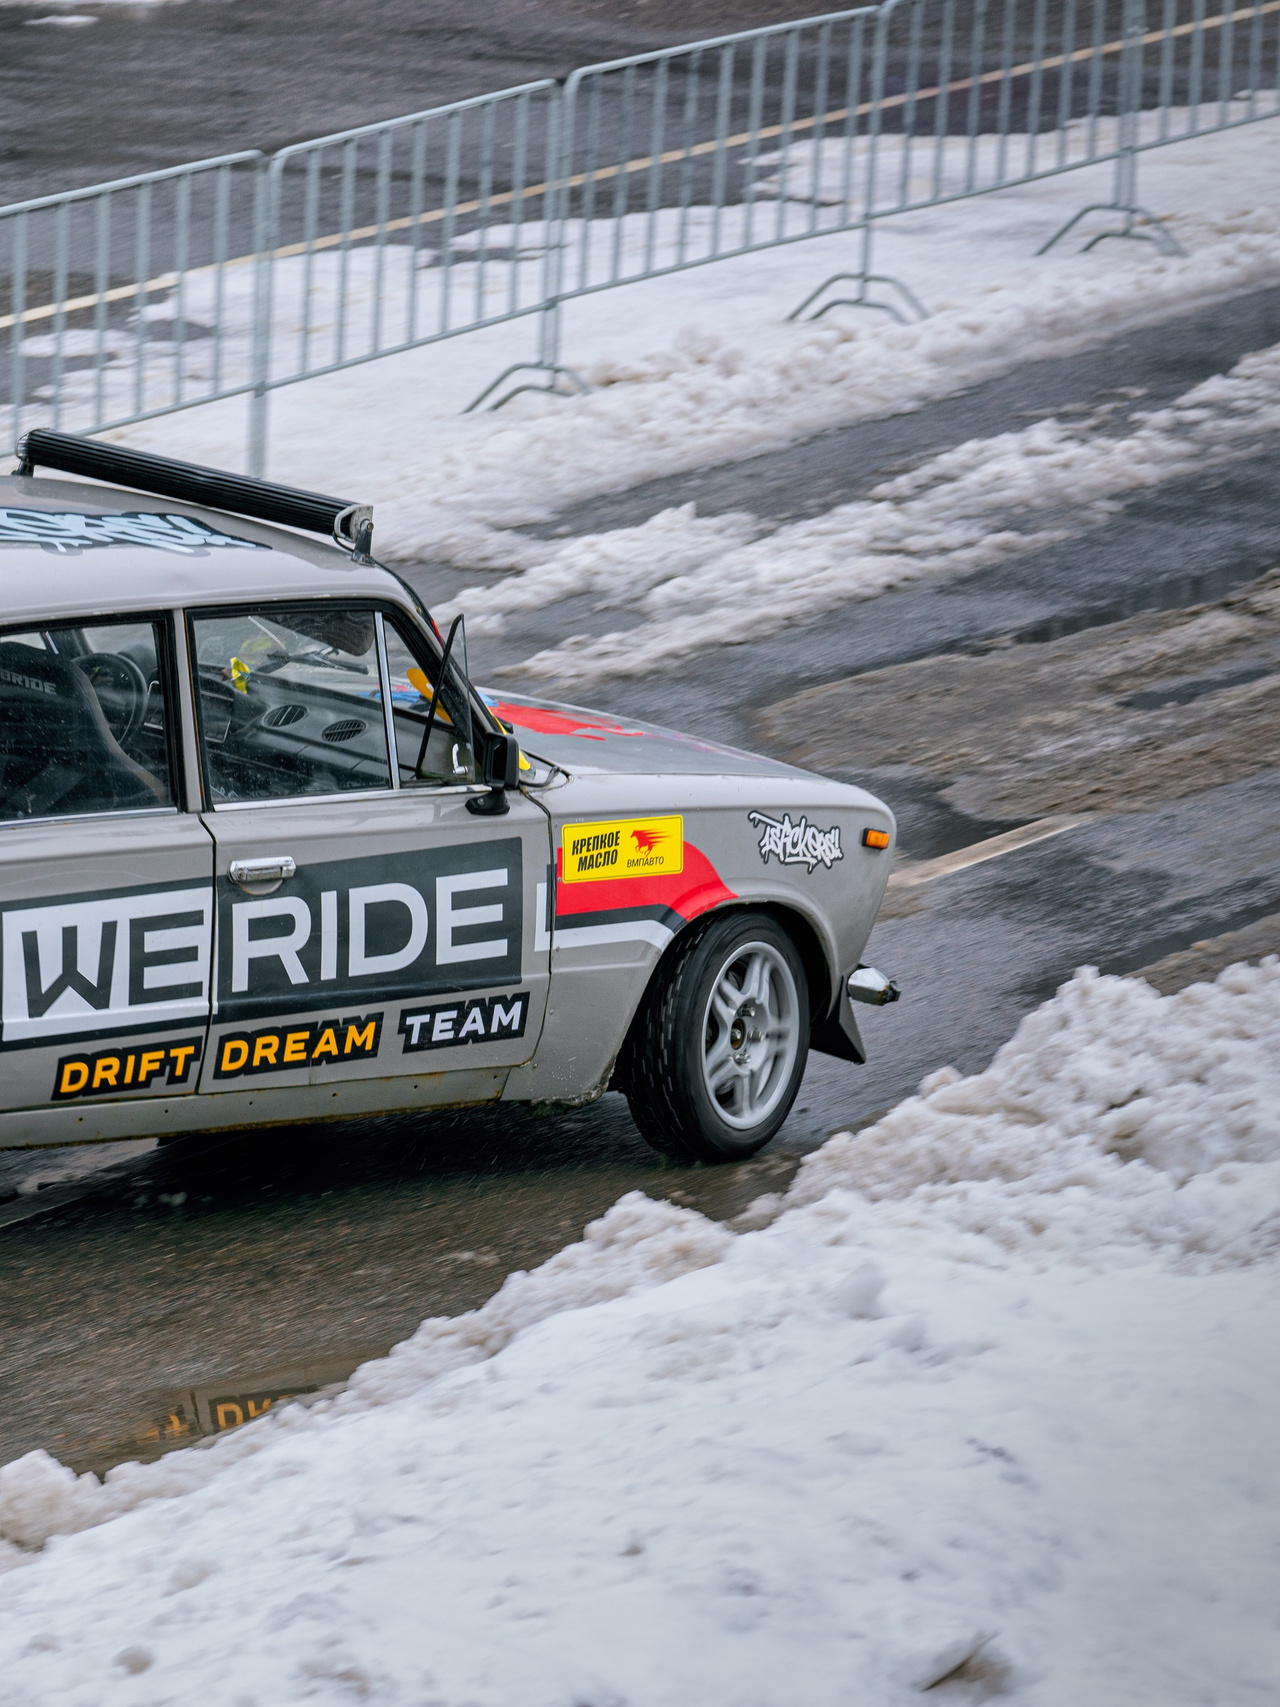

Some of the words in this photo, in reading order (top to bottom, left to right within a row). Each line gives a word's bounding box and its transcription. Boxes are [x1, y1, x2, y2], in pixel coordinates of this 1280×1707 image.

[571, 830, 621, 856] КРЕПКОЕ
[577, 848, 619, 873] МАСЛО
[626, 855, 665, 868] ВМПАВТО
[59, 1045, 196, 1094] DRIFT
[220, 1021, 377, 1073] DREAM
[405, 1000, 521, 1045] TEAM
